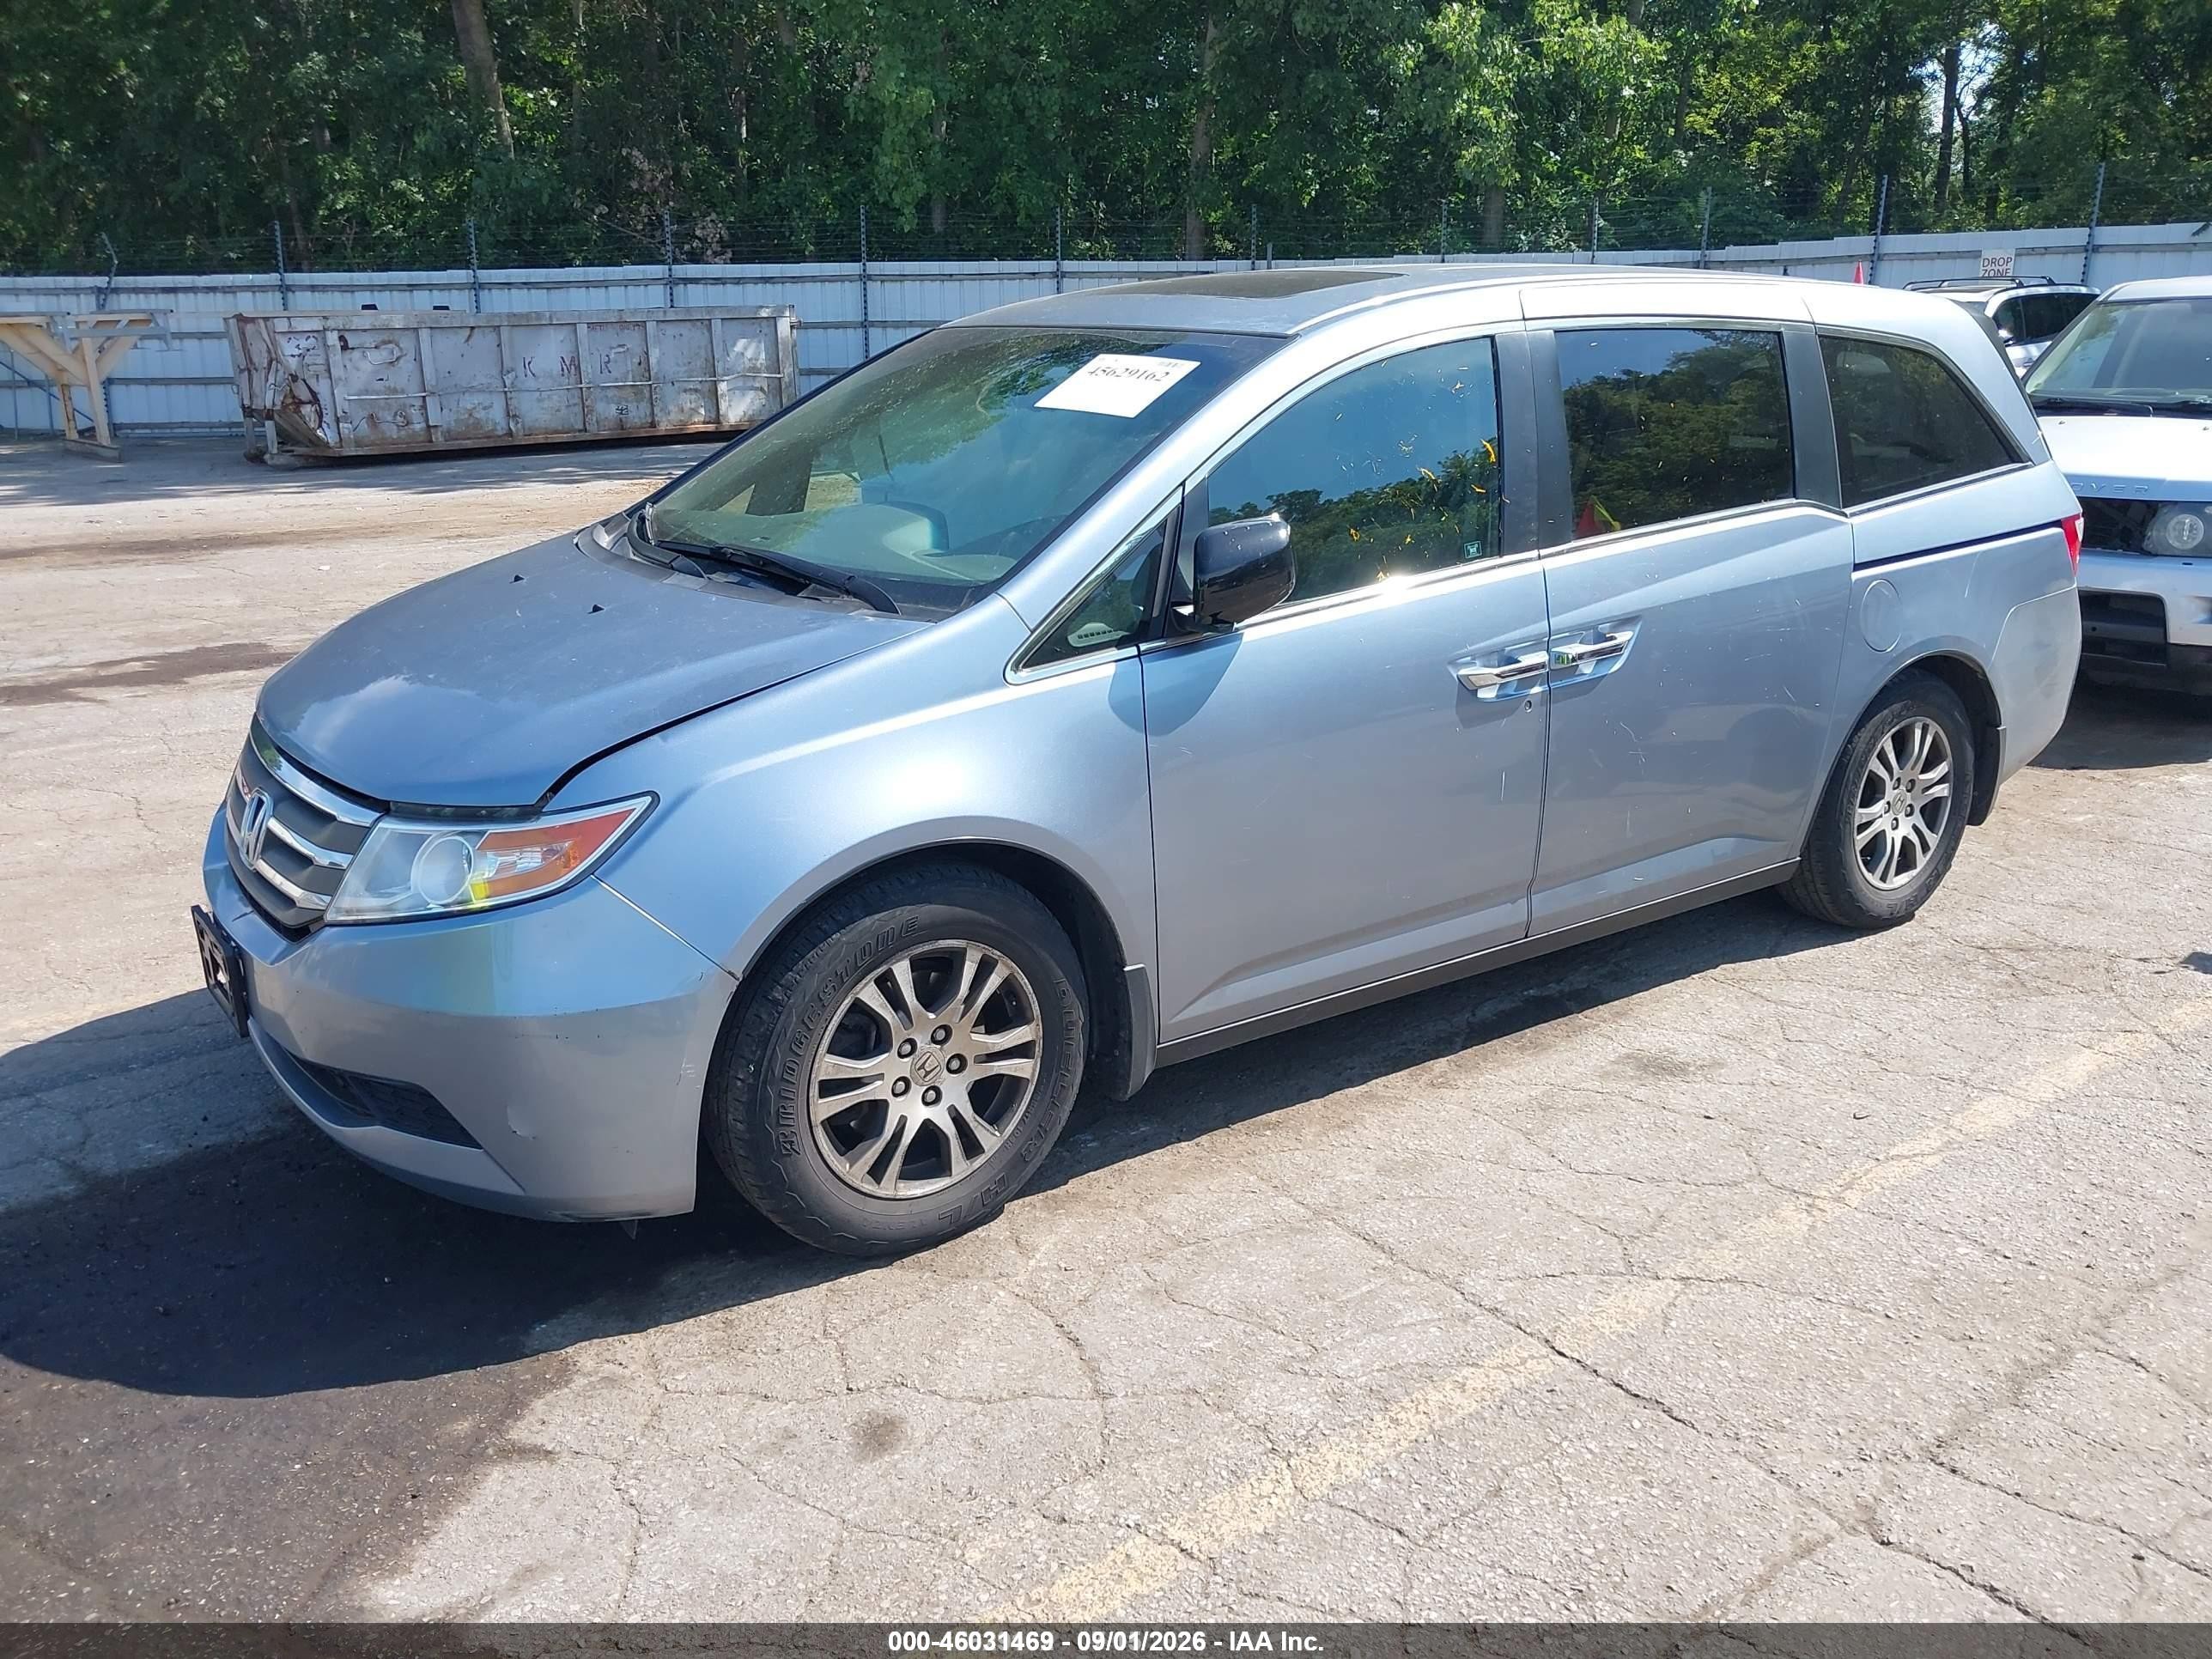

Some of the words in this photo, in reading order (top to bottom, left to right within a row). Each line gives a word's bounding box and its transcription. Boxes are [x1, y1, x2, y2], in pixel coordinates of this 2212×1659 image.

[1982, 257, 2013, 267] DROP
[1087, 366, 1170, 382] 45629162
[775, 915, 922, 1157] BRIDGESTONE
